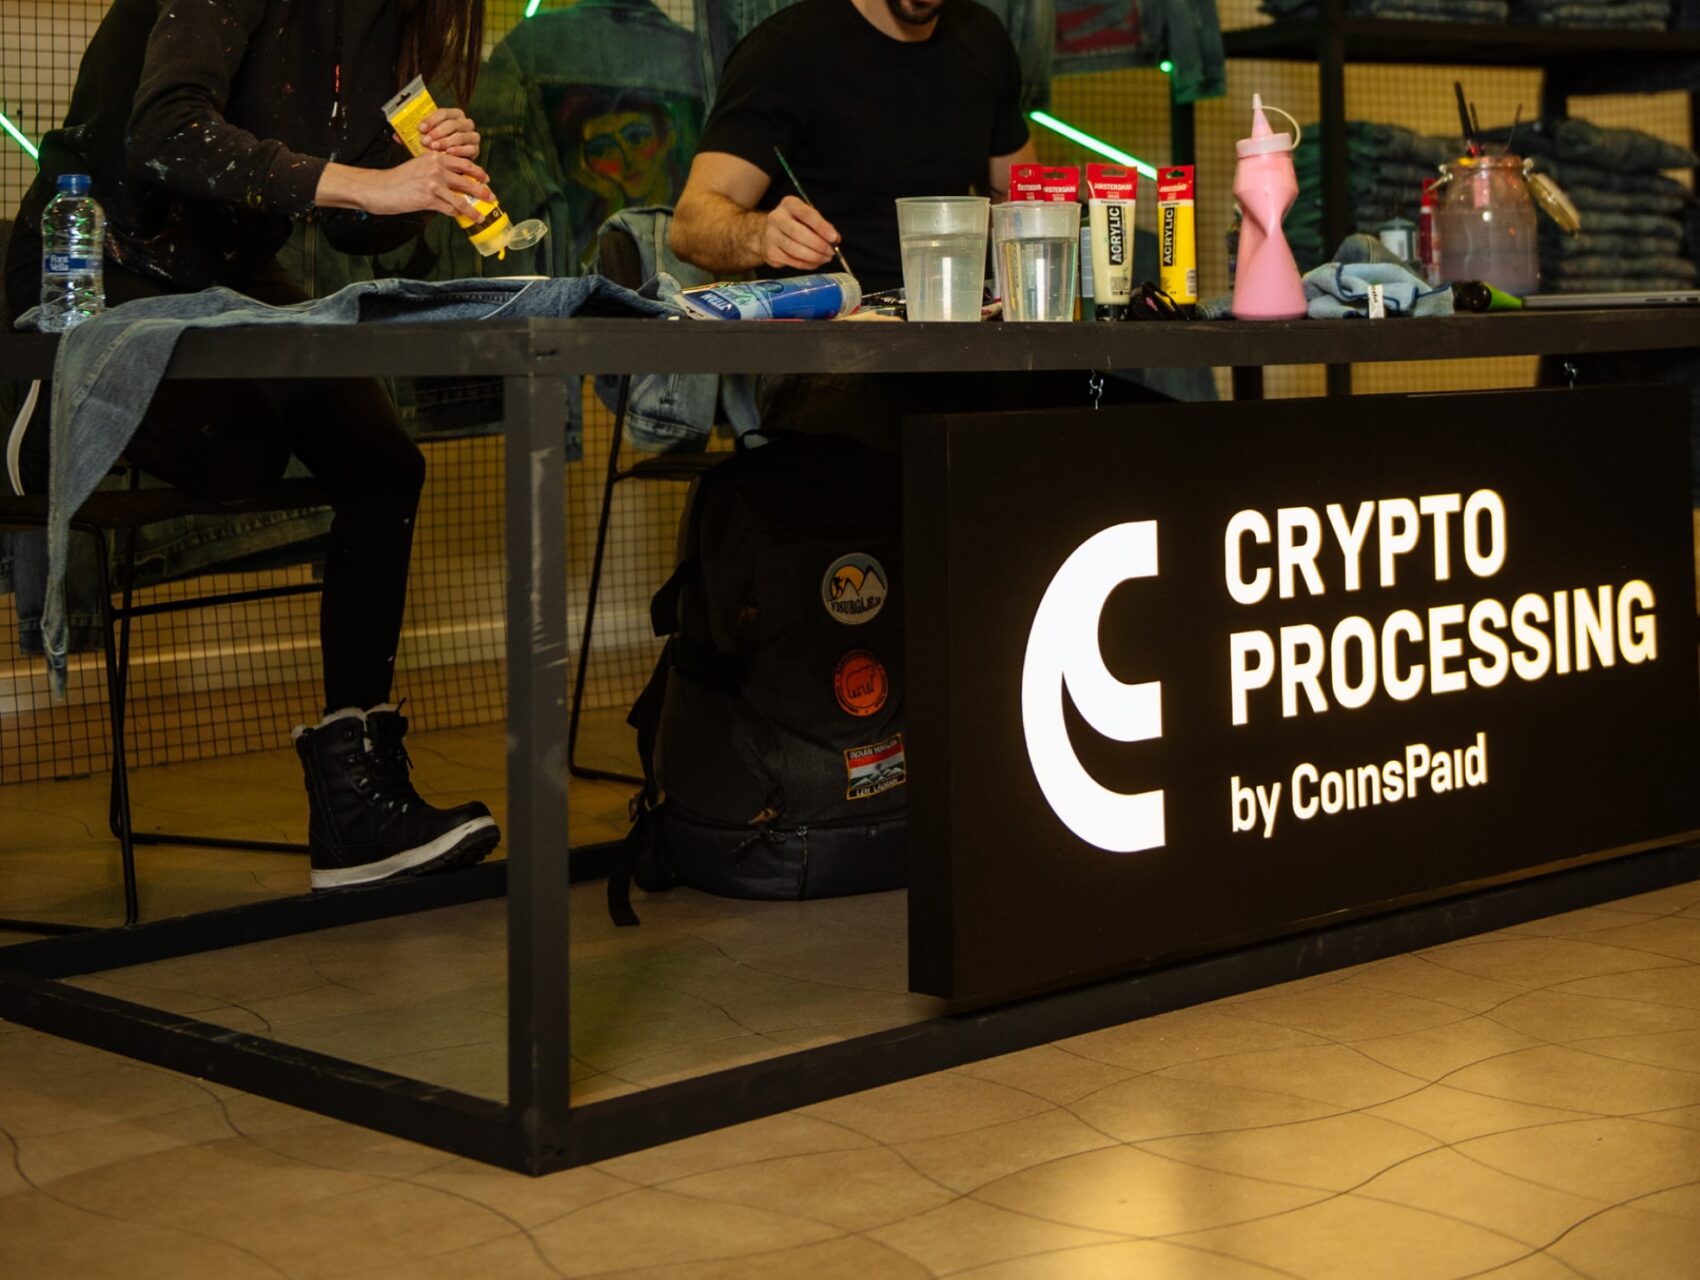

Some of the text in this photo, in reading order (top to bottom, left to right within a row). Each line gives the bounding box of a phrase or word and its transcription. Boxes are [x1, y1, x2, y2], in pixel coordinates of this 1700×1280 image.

[1109, 207, 1122, 263] ACRYLIC
[1164, 209, 1174, 264] ACRYLIC
[1224, 489, 1506, 605] CRYPTO
[1230, 579, 1657, 726] PROCESSING
[1230, 732, 1487, 839] by CoinsPaid
